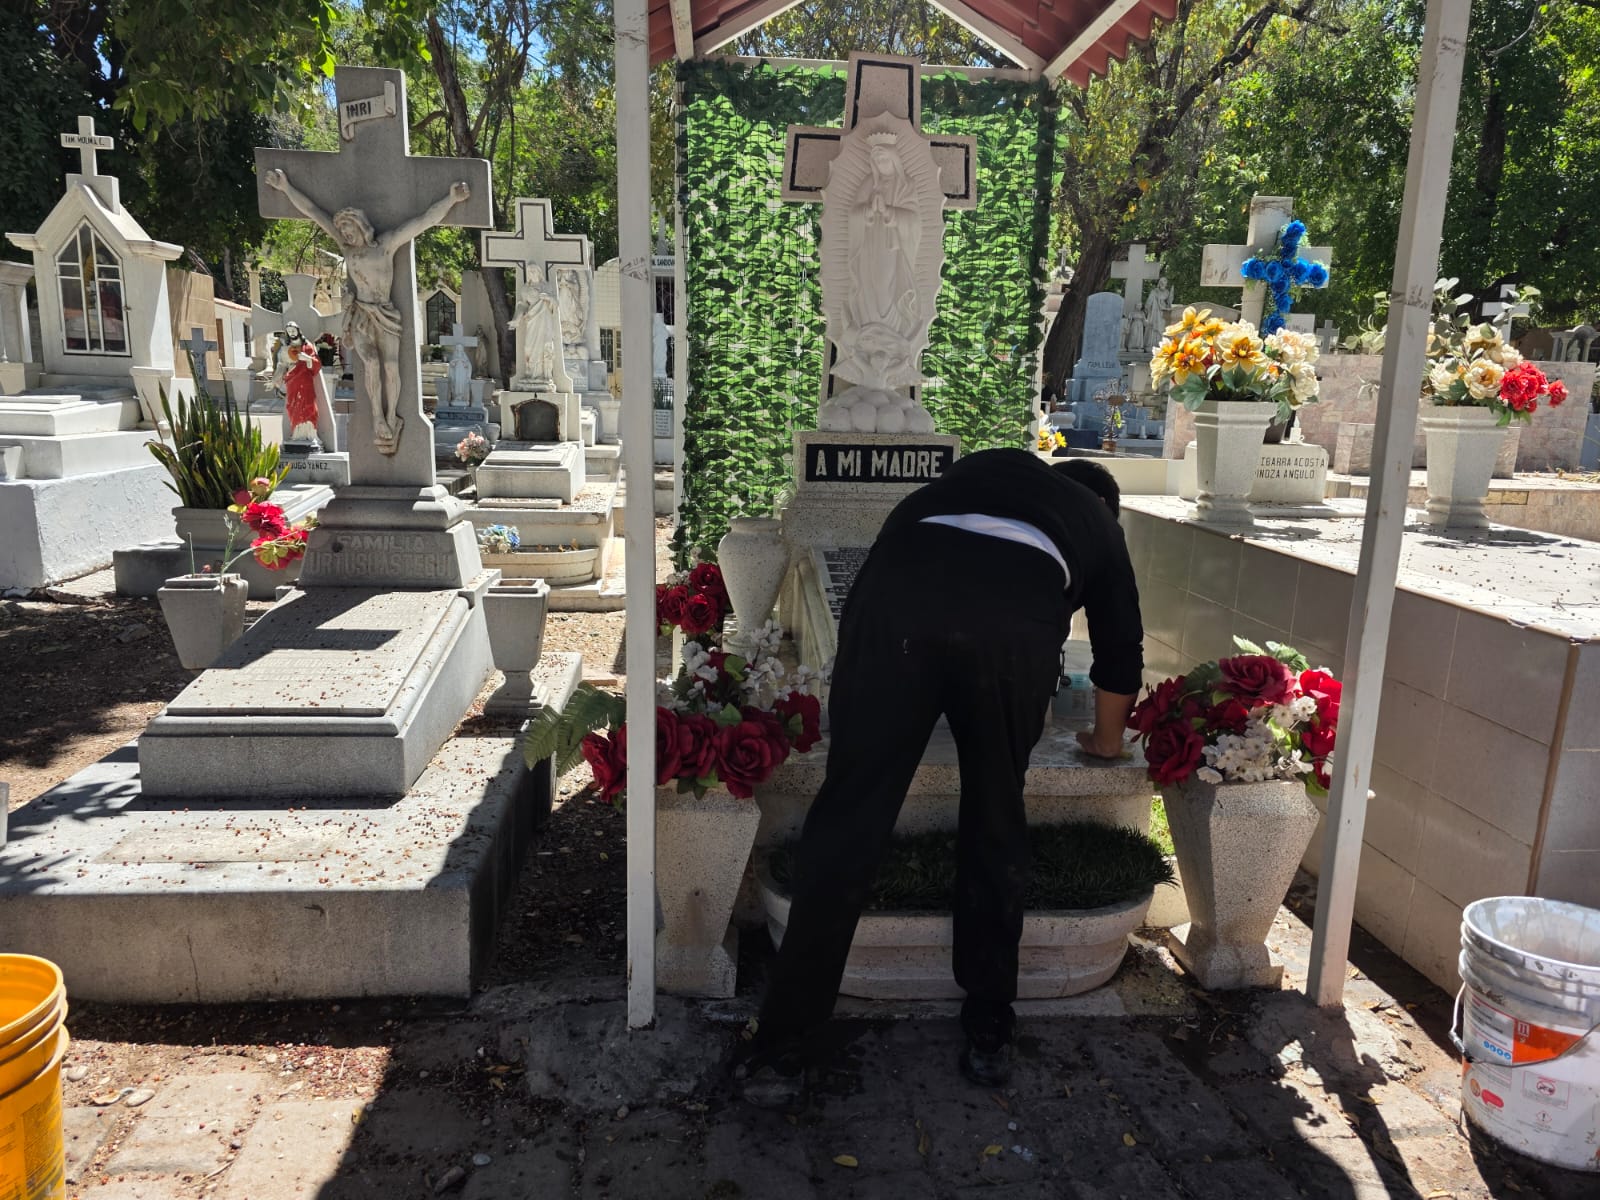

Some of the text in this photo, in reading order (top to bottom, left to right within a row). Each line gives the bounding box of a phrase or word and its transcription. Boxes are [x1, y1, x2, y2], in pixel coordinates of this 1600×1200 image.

[346, 101, 372, 119] INRI
[815, 449, 944, 478] A MI MADRE
[1260, 456, 1325, 467] IBARRA ACOSTA
[1255, 469, 1315, 480] INOZA ANGULO
[336, 535, 425, 551] FAMILIA
